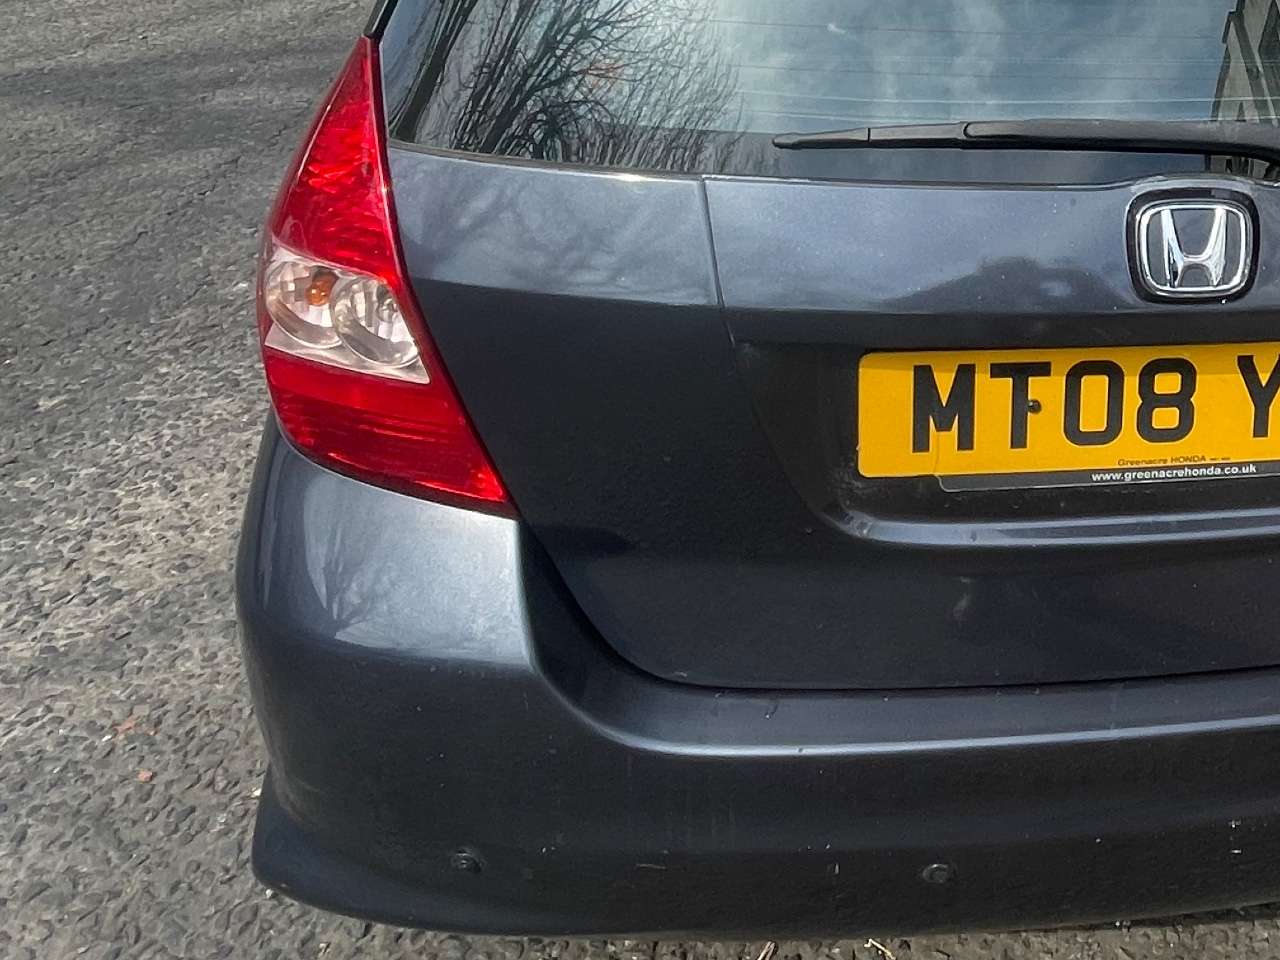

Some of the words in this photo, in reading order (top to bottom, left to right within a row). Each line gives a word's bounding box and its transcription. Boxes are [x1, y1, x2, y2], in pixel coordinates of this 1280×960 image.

[913, 357, 1198, 454] MT08
[1118, 457, 1168, 467] Greenacre
[1170, 455, 1207, 464] HONDA
[1091, 463, 1258, 483] www.greenacrehonda.co.uk
